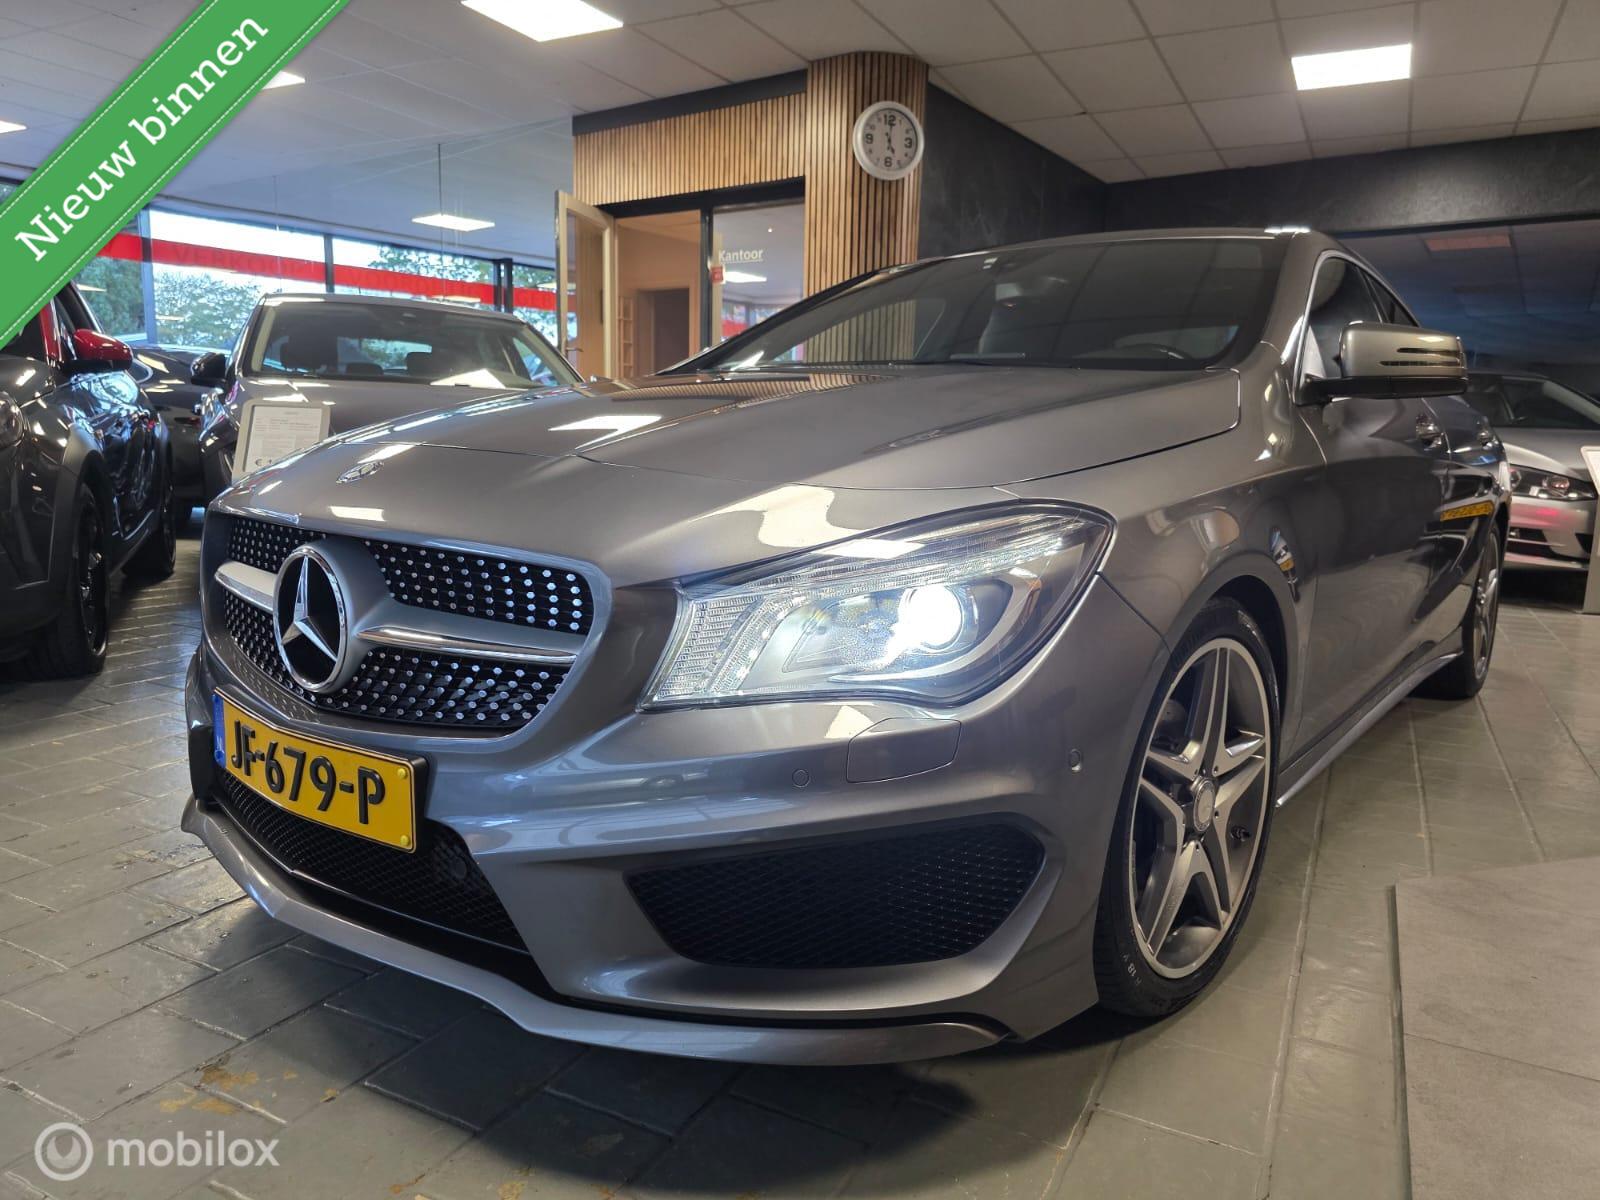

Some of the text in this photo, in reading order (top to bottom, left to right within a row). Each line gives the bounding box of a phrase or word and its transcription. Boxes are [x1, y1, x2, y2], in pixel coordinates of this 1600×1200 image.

[883, 113, 896, 126] 12
[865, 133, 874, 144] 9
[904, 137, 913, 149] 3
[884, 156, 893, 168] 6
[718, 248, 763, 262] Kantoor
[231, 720, 386, 825] JF-679-P
